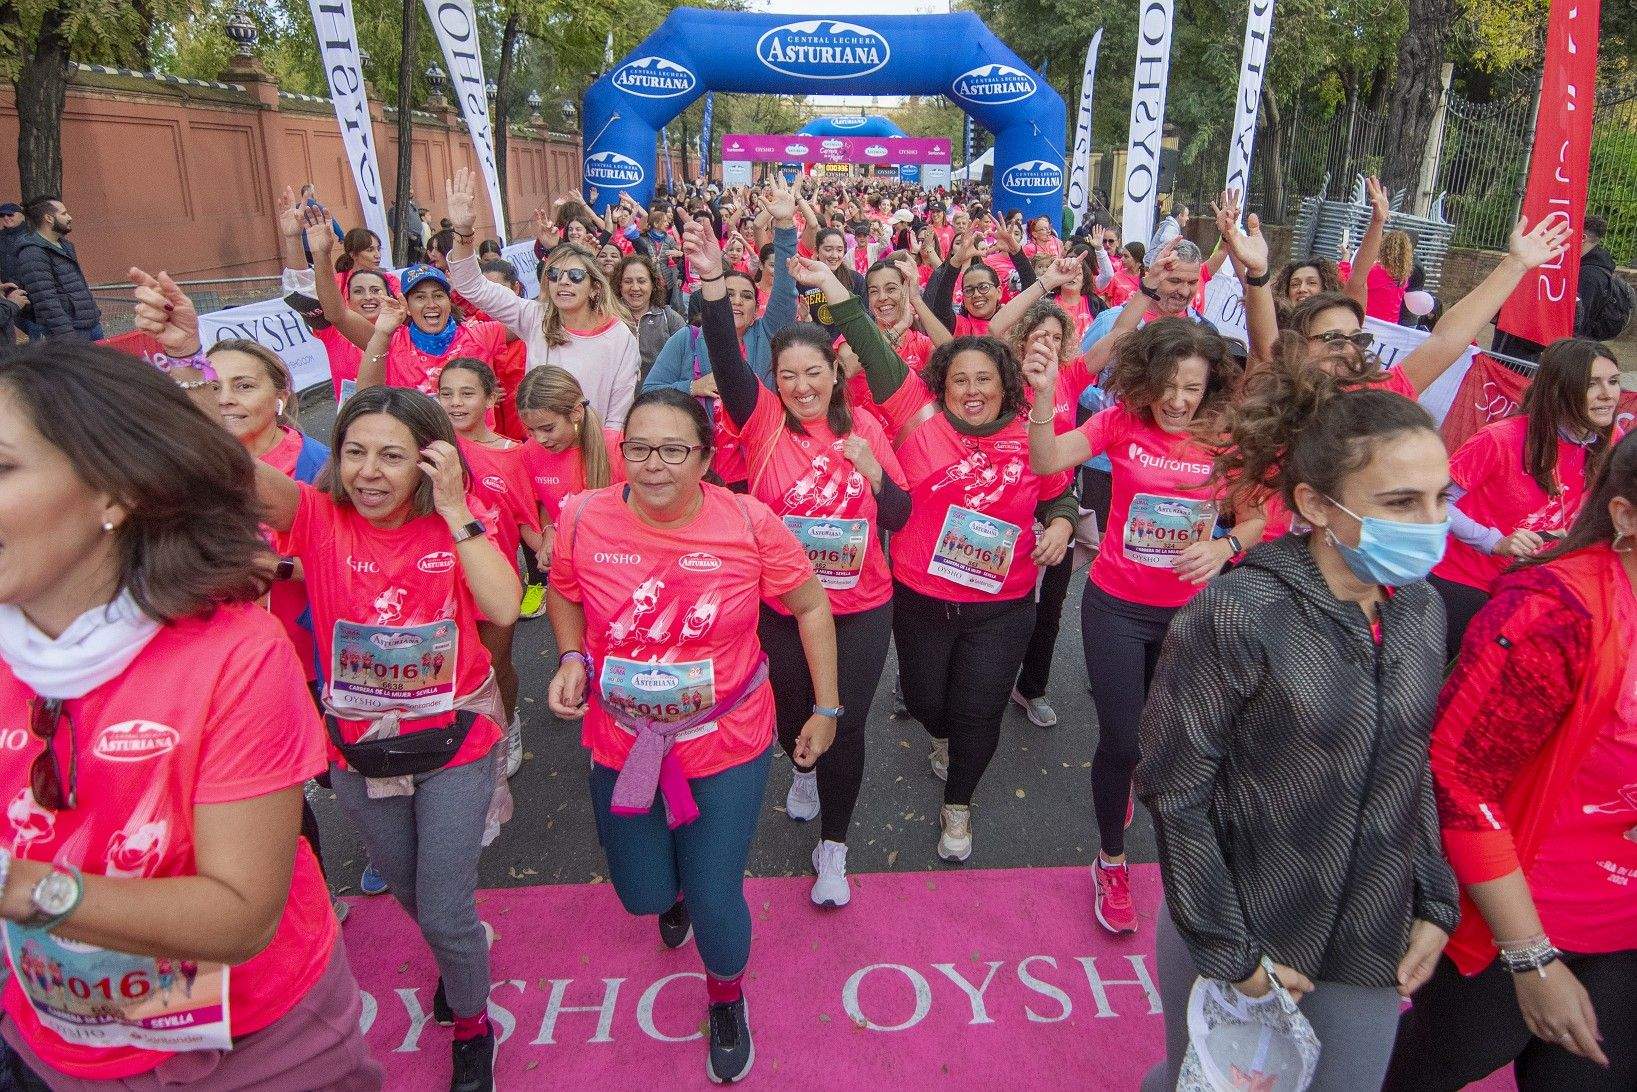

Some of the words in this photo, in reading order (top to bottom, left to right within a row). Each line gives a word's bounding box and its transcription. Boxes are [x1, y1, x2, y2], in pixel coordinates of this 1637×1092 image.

[787, 36, 830, 44] CENTRAL
[833, 36, 876, 44] LECHERA
[767, 36, 880, 64] ASTURIANA
[617, 70, 689, 89] ASTURIANA
[960, 80, 1032, 95] ASTURIANA
[585, 162, 639, 180] ASTURIANA
[1005, 173, 1060, 187] ASTURIANA
[1155, 527, 1189, 541] 016
[594, 552, 641, 565] OYSHO
[808, 549, 839, 562] 016
[963, 544, 992, 562] 016
[374, 663, 419, 679] 016
[67, 969, 151, 1001] 016
